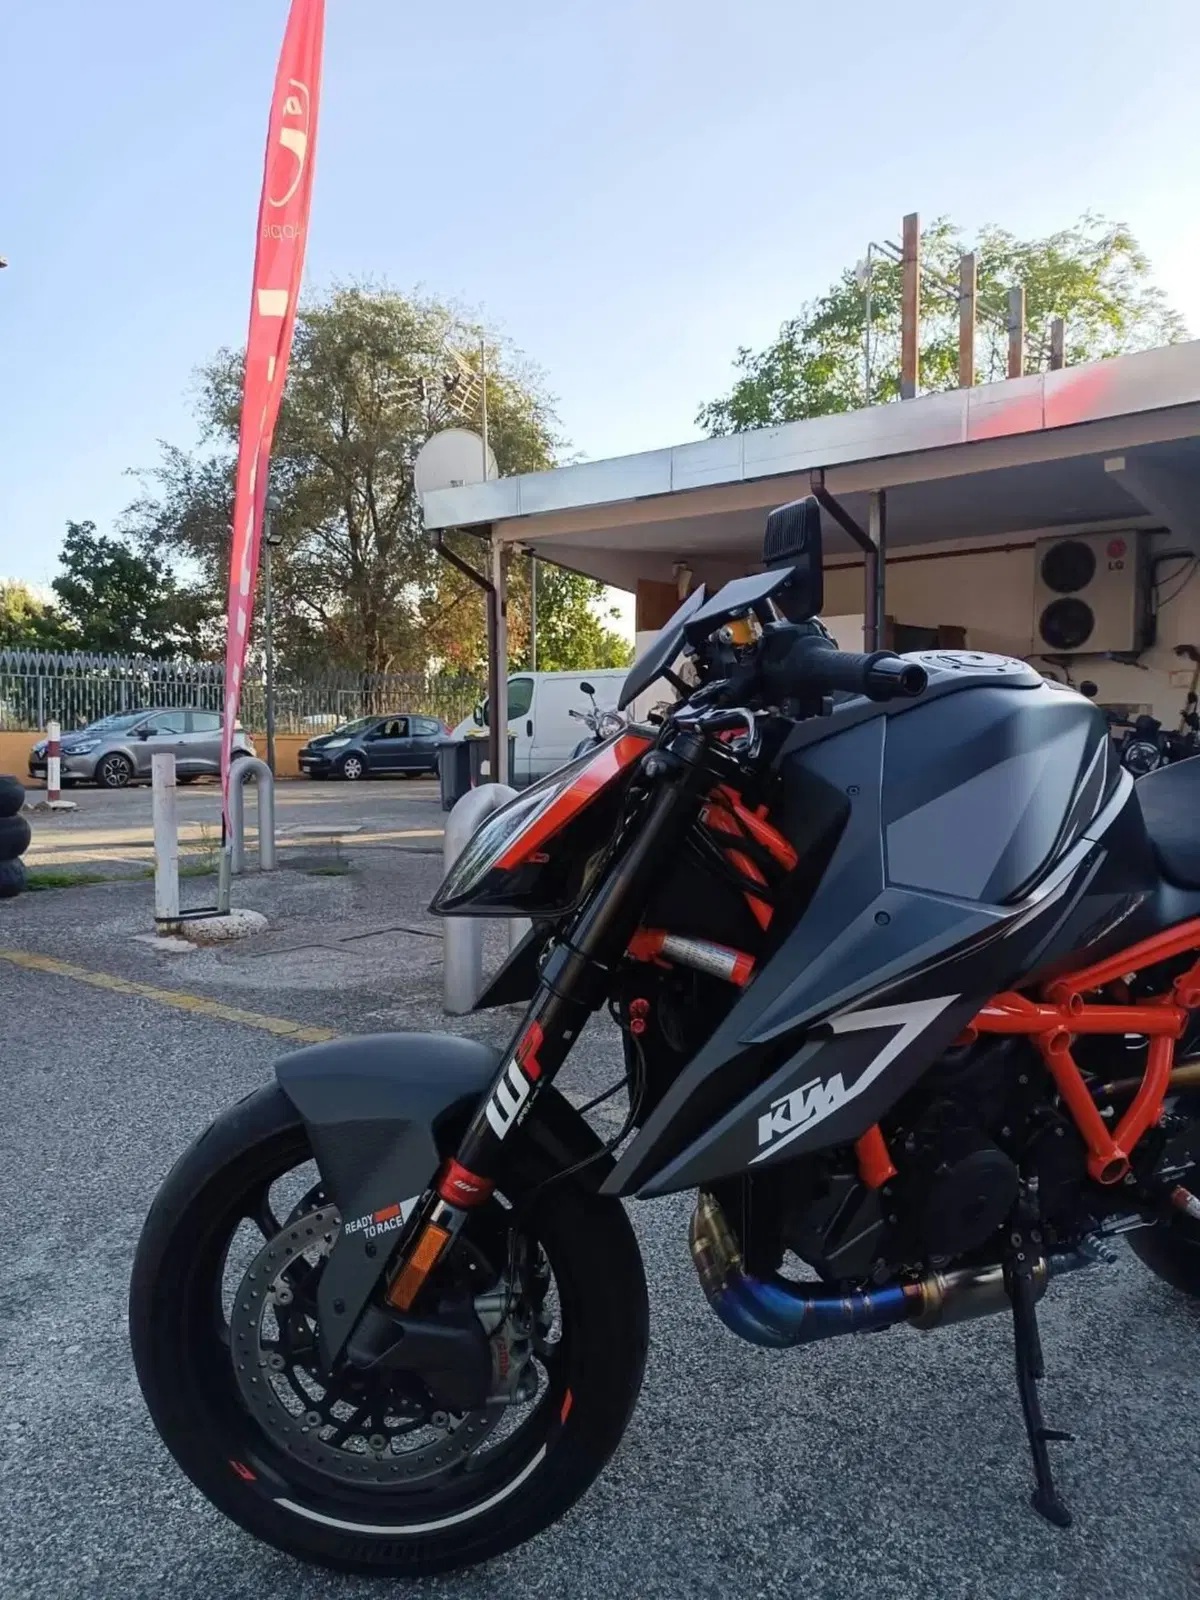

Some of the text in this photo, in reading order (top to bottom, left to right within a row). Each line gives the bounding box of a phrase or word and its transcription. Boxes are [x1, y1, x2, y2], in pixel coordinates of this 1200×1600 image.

[1108, 560, 1125, 570] LG
[486, 1019, 544, 1140] WP
[758, 1072, 848, 1146] KTM
[344, 1213, 373, 1235] READY
[363, 1215, 402, 1239] TO RACE
